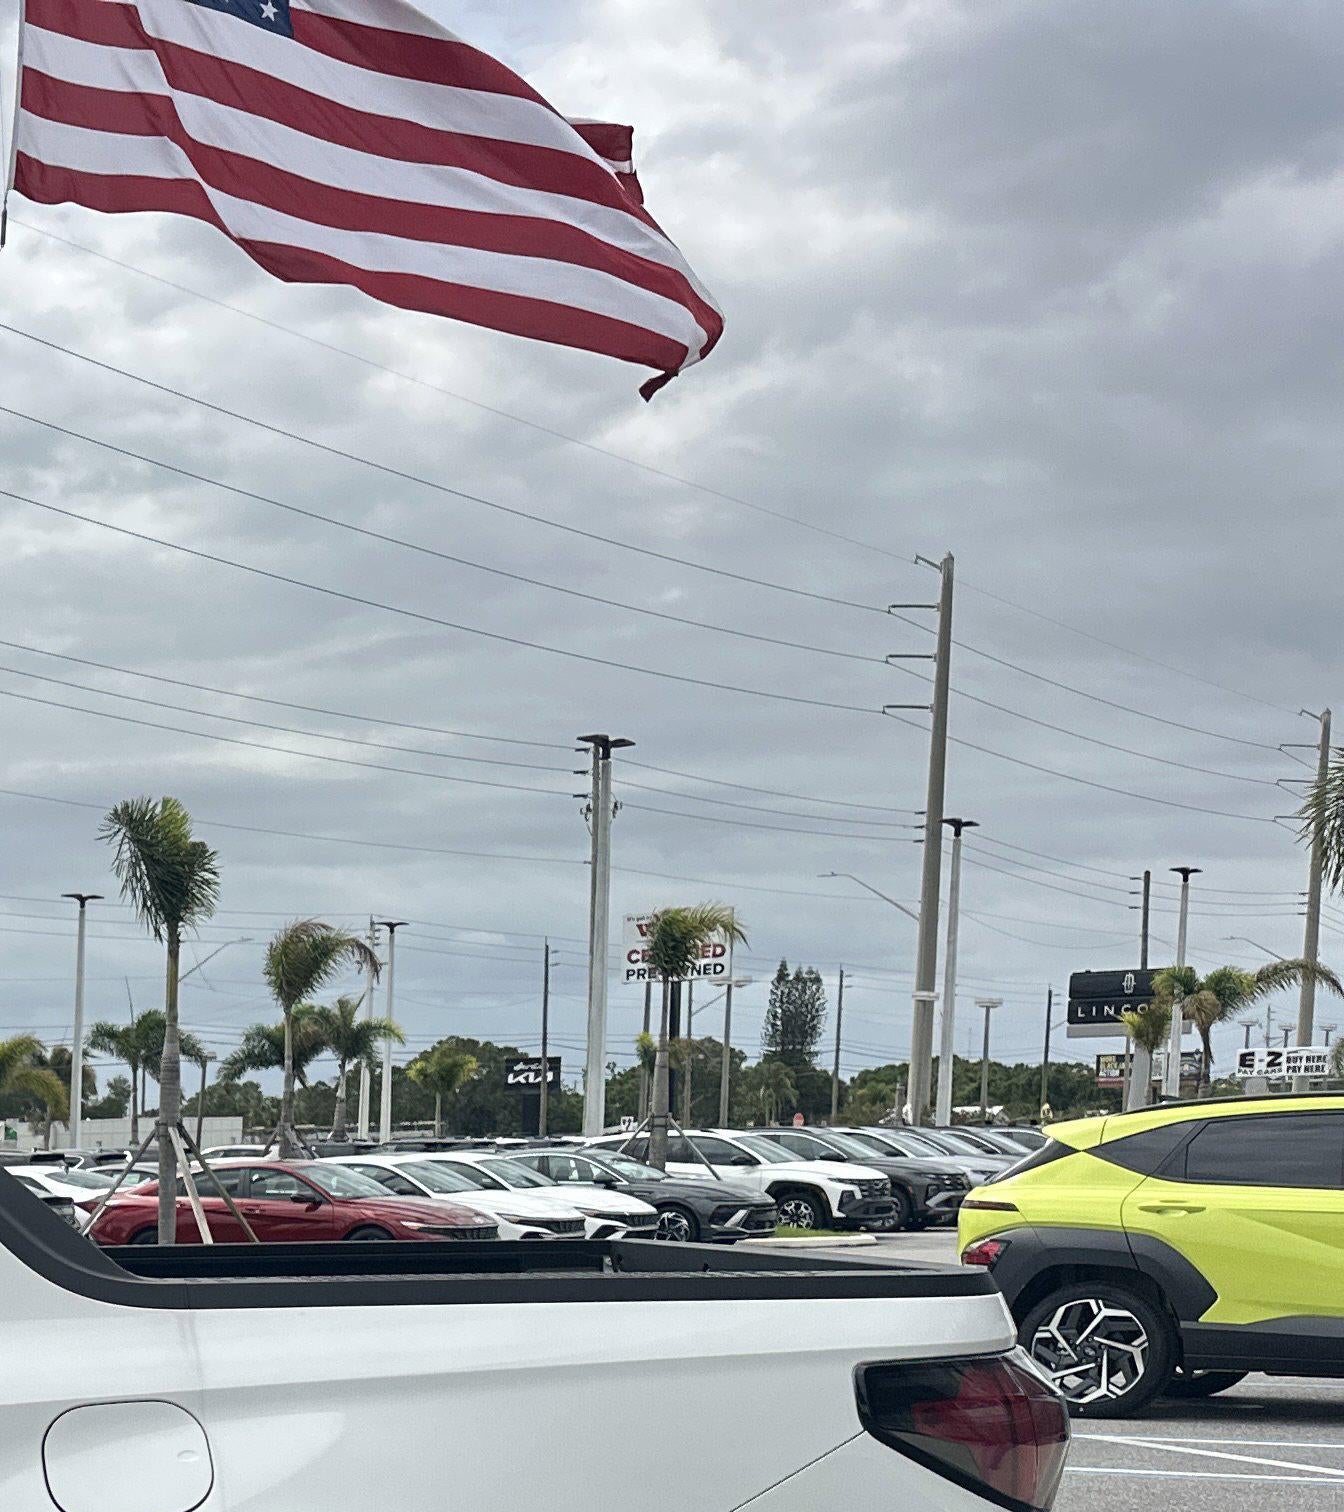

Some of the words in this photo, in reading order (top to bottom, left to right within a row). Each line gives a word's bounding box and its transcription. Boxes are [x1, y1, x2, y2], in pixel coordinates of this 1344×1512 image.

[625, 963, 725, 981] PRENED
[1077, 1003, 1149, 1018] LINCO
[1239, 1051, 1283, 1068] E-Z
[1286, 1055, 1303, 1064] BUY
[1305, 1054, 1328, 1064] HERE
[1286, 1065, 1303, 1074] PAY
[1303, 1064, 1326, 1073] HERE
